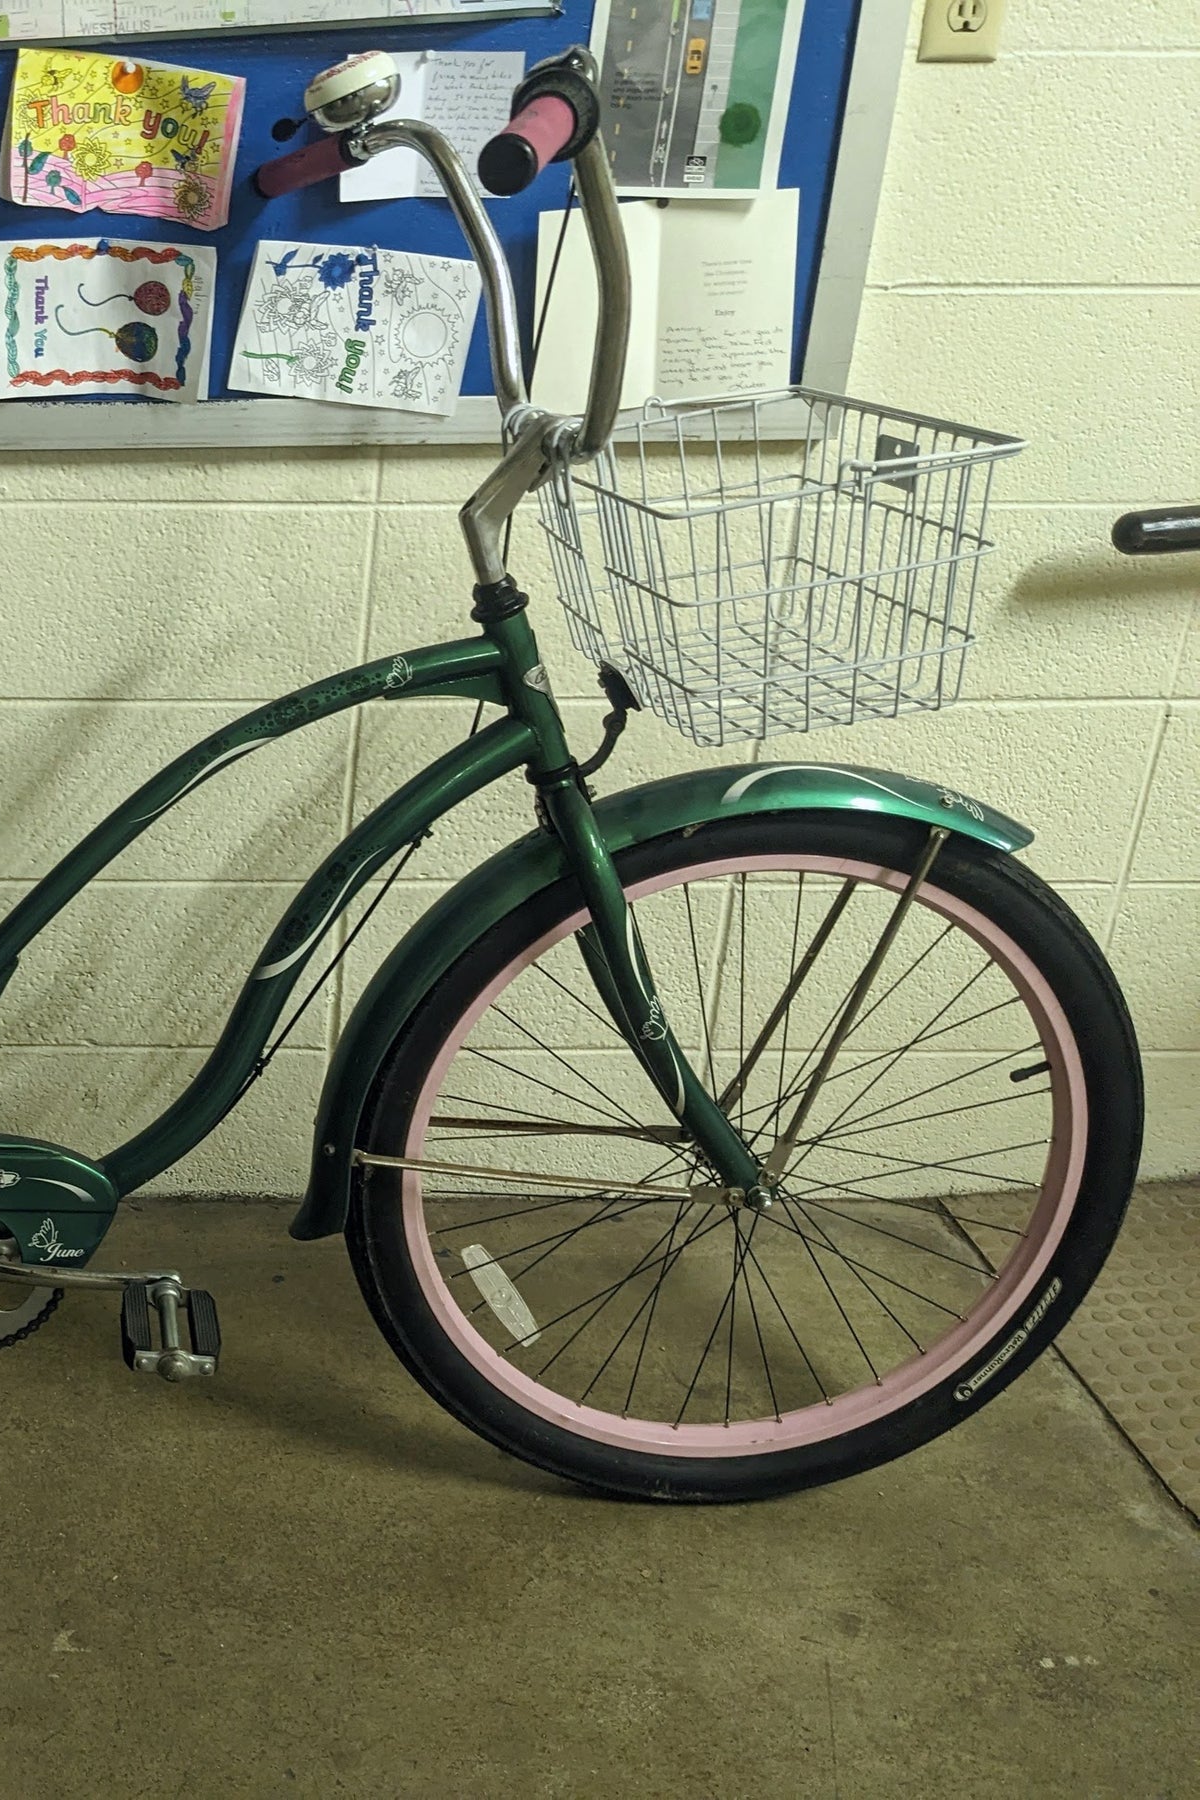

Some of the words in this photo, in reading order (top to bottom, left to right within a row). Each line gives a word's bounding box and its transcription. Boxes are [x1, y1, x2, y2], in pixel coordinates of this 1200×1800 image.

[80, 22, 113, 35] WEST
[118, 19, 151, 33] ALLIS
[27, 94, 133, 128] Thank
[140, 109, 210, 155] you!
[34, 275, 49, 325] Thank
[357, 252, 379, 332] Thank
[34, 328, 47, 358] You
[335, 338, 366, 394] you!
[40, 1243, 85, 1262] June
